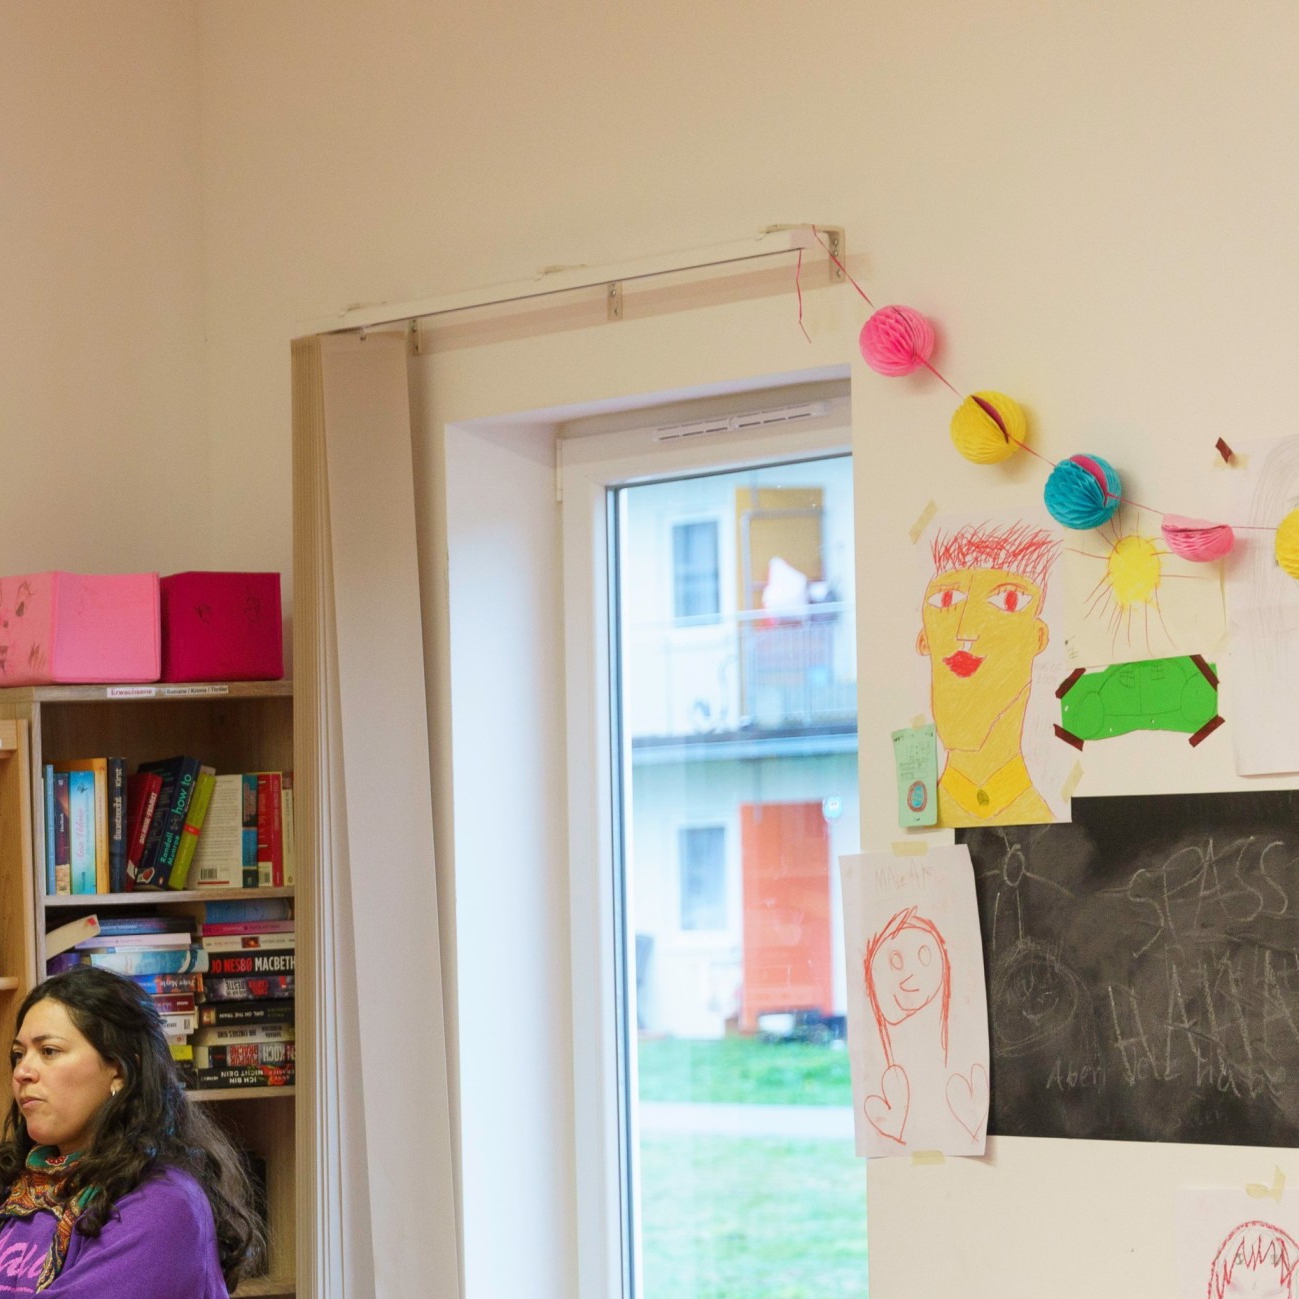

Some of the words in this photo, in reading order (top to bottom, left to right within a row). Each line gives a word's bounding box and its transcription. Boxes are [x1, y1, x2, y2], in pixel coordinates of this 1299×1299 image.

[172, 789, 188, 815] how
[180, 773, 193, 788] to
[160, 831, 174, 864] Randall
[211, 959, 221, 974] JO
[255, 956, 295, 971] MACBETH
